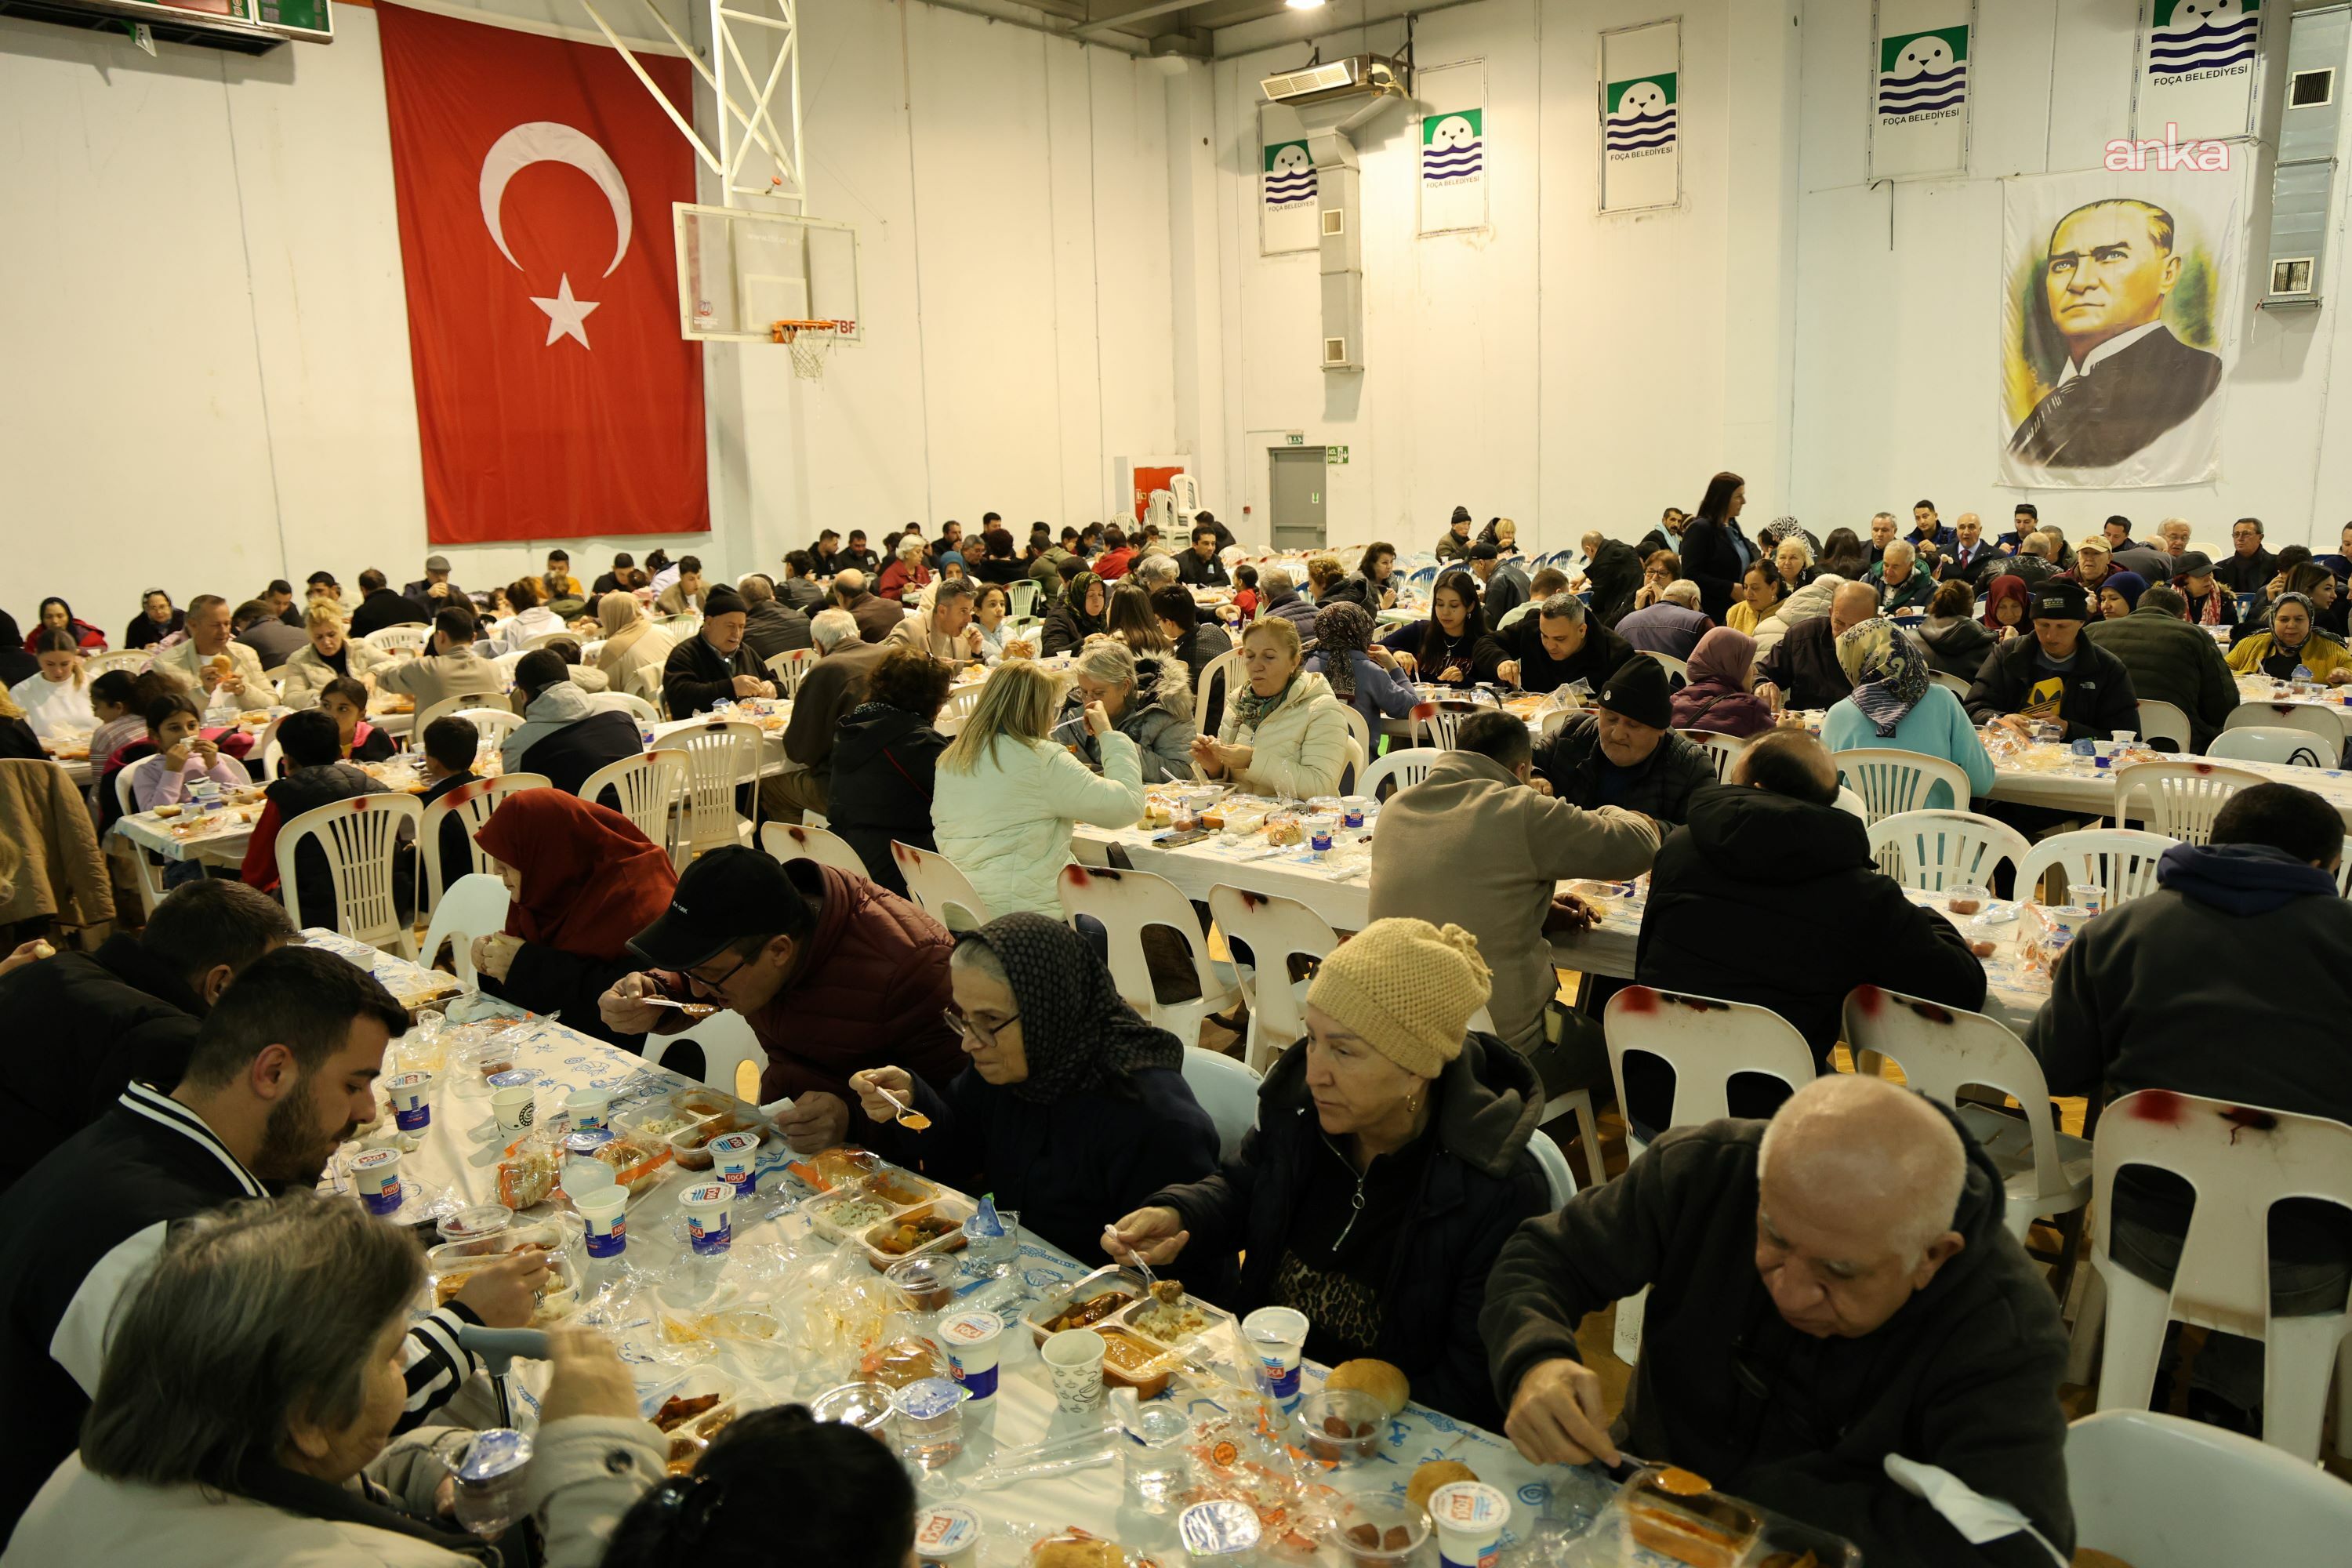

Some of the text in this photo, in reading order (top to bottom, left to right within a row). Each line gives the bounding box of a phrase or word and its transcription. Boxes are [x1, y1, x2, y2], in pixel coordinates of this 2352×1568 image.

[2154, 64, 2248, 85] FOÇA BELEDİYESİ
[1883, 107, 1959, 125] FOÇA BELEDİYESİ
[1610, 146, 1673, 162] FOÇA BELEDİYESİ
[1444, 174, 1479, 187] BELEDİYESİ
[728, 1174, 744, 1182] FOÇA
[614, 1222, 626, 1235] FOÇ
[690, 1226, 702, 1236] OÇA
